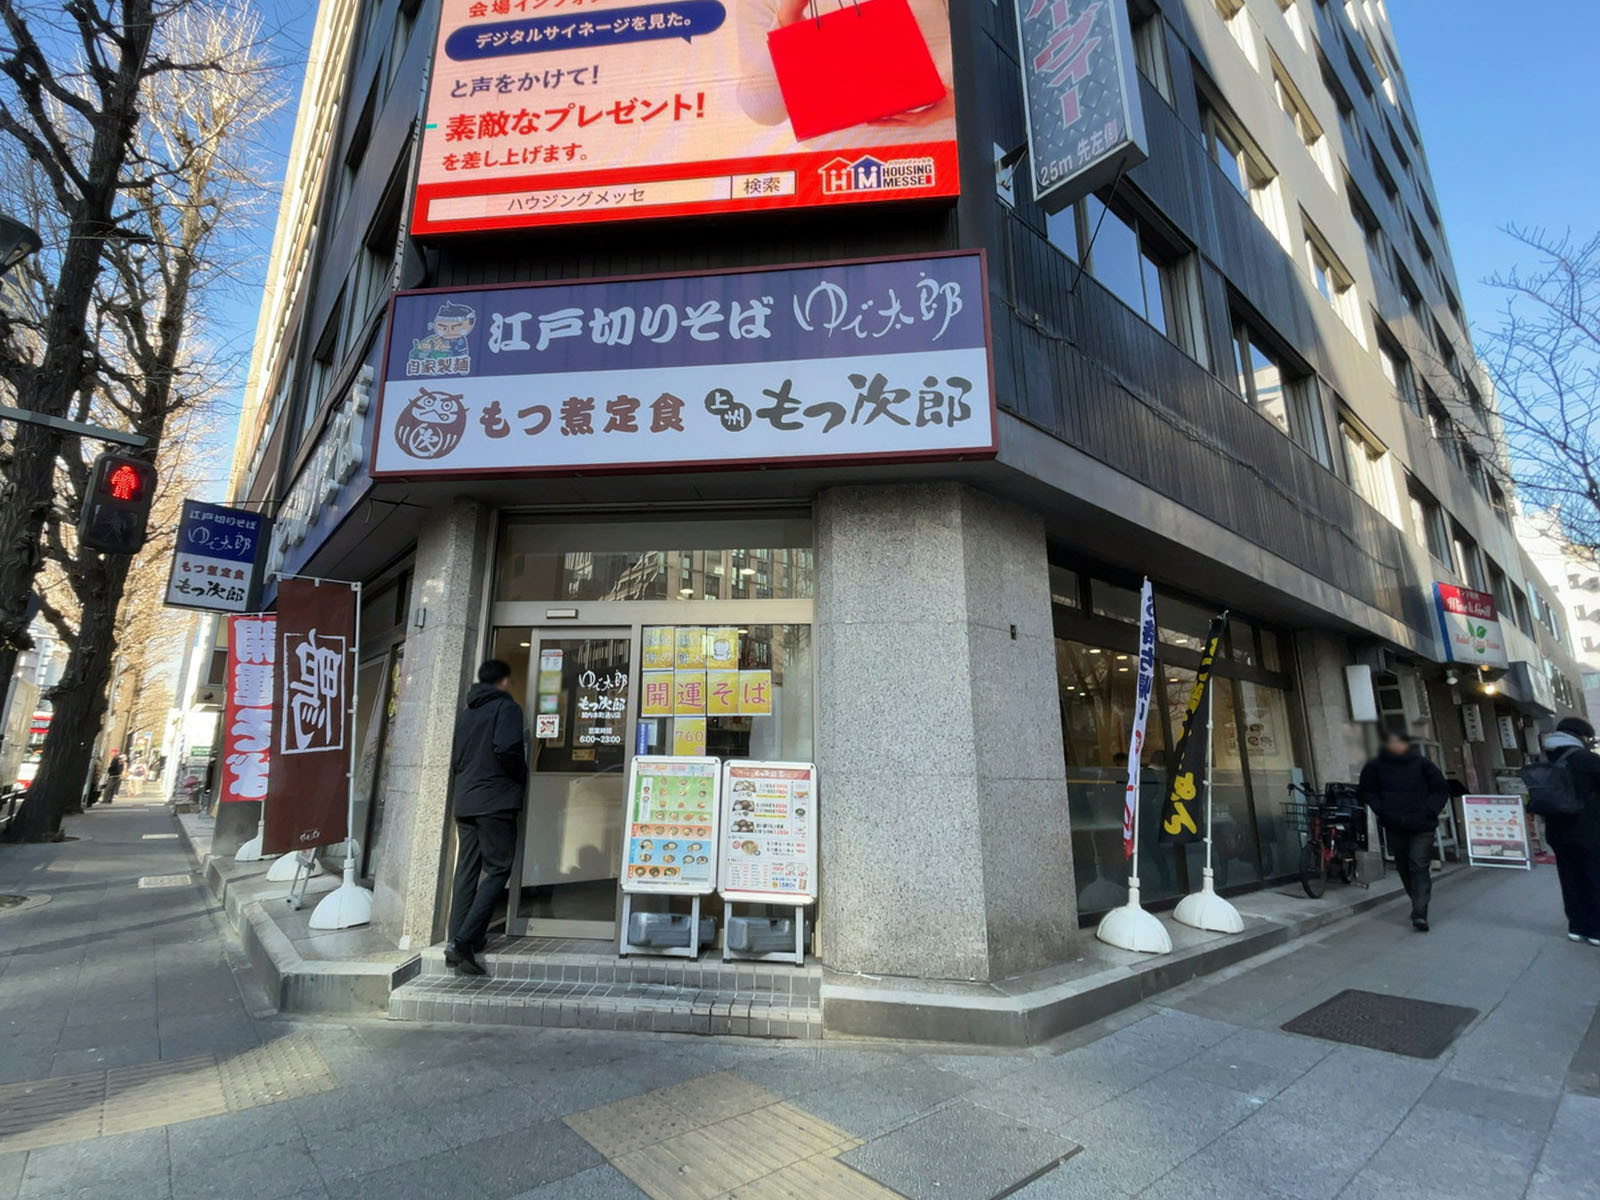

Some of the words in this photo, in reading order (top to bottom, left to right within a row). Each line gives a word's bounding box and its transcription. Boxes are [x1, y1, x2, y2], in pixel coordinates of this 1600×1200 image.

[476, 12, 692, 49] デジタルサイネージを見た。
[445, 92, 705, 142] 素敵なプレゼント!
[442, 142, 587, 171] を差し上げます。
[882, 164, 932, 178] HOUSING
[883, 175, 925, 188] MESSE
[1040, 155, 1073, 186] 25m
[507, 188, 645, 212] ハウジングメッセ
[743, 177, 781, 195] 検索
[488, 295, 774, 353] 江戸切りそば
[793, 272, 963, 341] ゆで太郎
[407, 357, 470, 376] 自家製麺
[479, 391, 686, 438] もつ煮定食
[756, 372, 972, 434] もつ次郎
[189, 509, 257, 530] 江戸切りそば
[188, 526, 252, 556] ゆで太郎
[182, 561, 245, 580] もつ煮定食
[175, 578, 245, 602] もつ次郎
[579, 669, 628, 693] ゆで太郎
[646, 680, 769, 707] 開運そば
[578, 695, 626, 711] もつ次郎
[675, 731, 704, 743] 760
